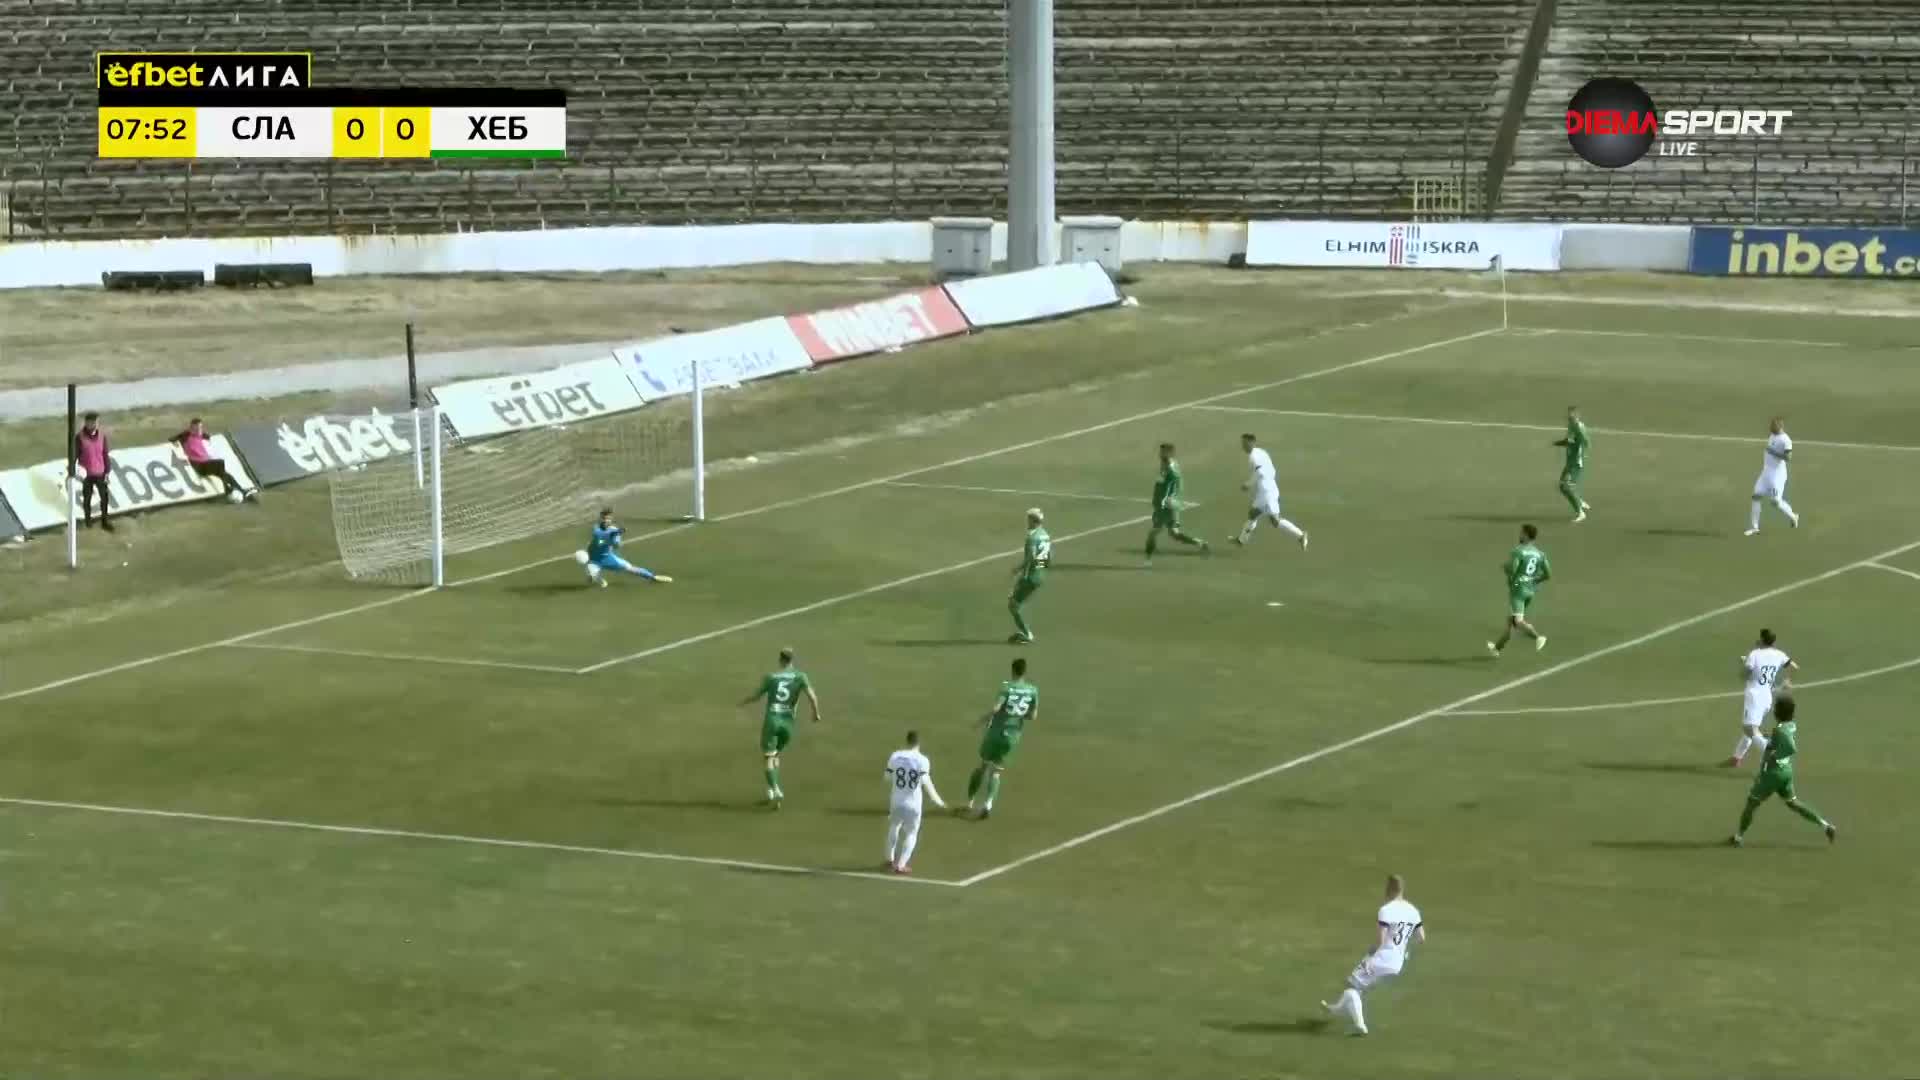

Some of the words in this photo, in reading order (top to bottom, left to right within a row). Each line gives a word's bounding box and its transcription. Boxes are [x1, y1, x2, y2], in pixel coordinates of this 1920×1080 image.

[1325, 239, 1386, 253] ELHIM
[1423, 241, 1480, 253] ISKRA
[1728, 231, 1920, 274] inbet.c
[776, 680, 790, 702] 5
[895, 766, 920, 790] 88
